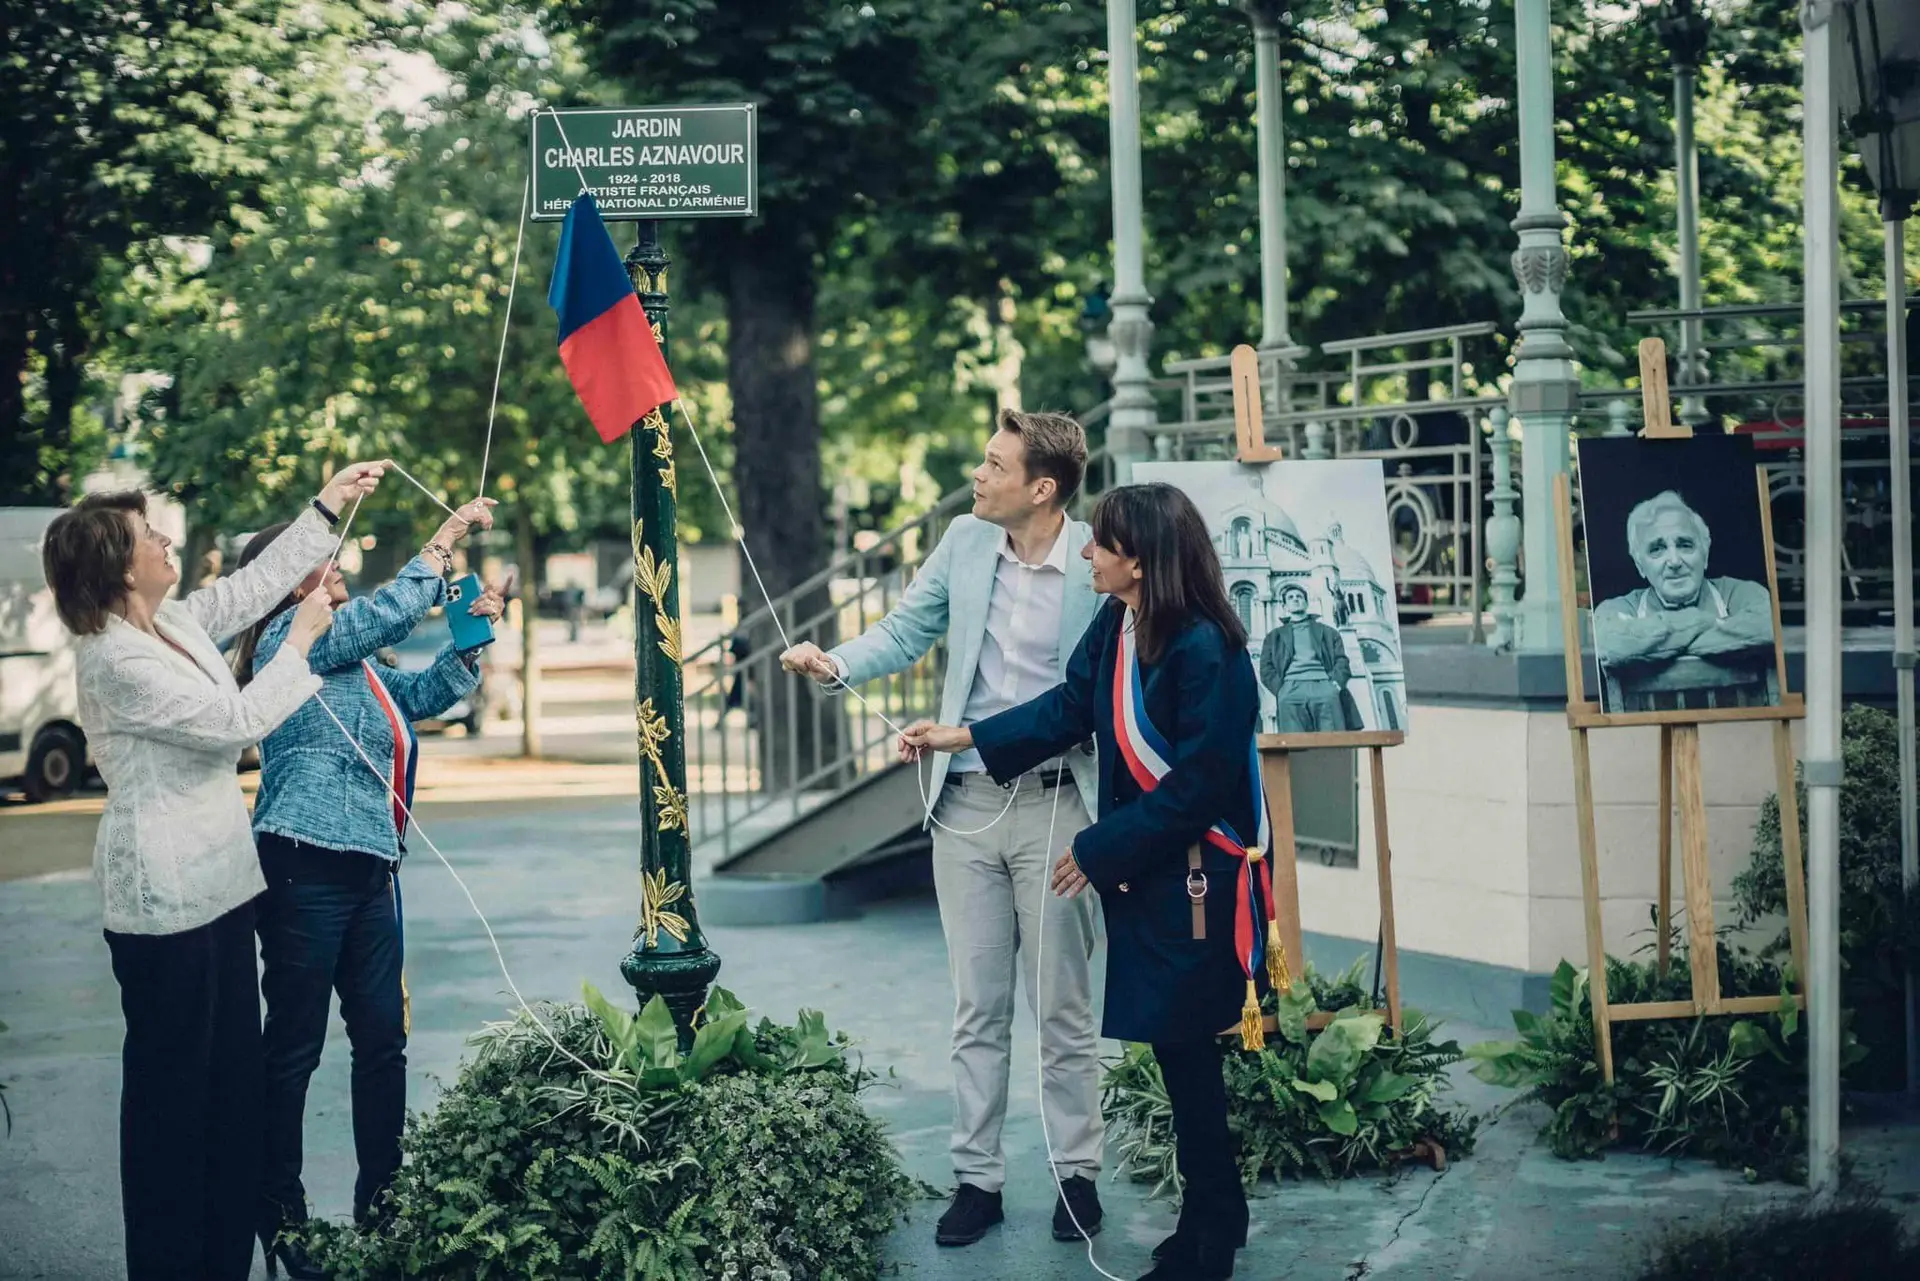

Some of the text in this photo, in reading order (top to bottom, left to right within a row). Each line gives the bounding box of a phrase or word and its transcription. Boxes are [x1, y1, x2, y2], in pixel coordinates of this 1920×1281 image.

[611, 118, 681, 138] JARDIN
[544, 144, 744, 168] CHARLES AZNAVOUR
[608, 174, 638, 184] 1924
[650, 173, 681, 183] 2018
[578, 184, 711, 196] ARTISTE FRANÇAIS
[543, 194, 746, 210] HÉR NATIONAL D'ARMÉNIE
